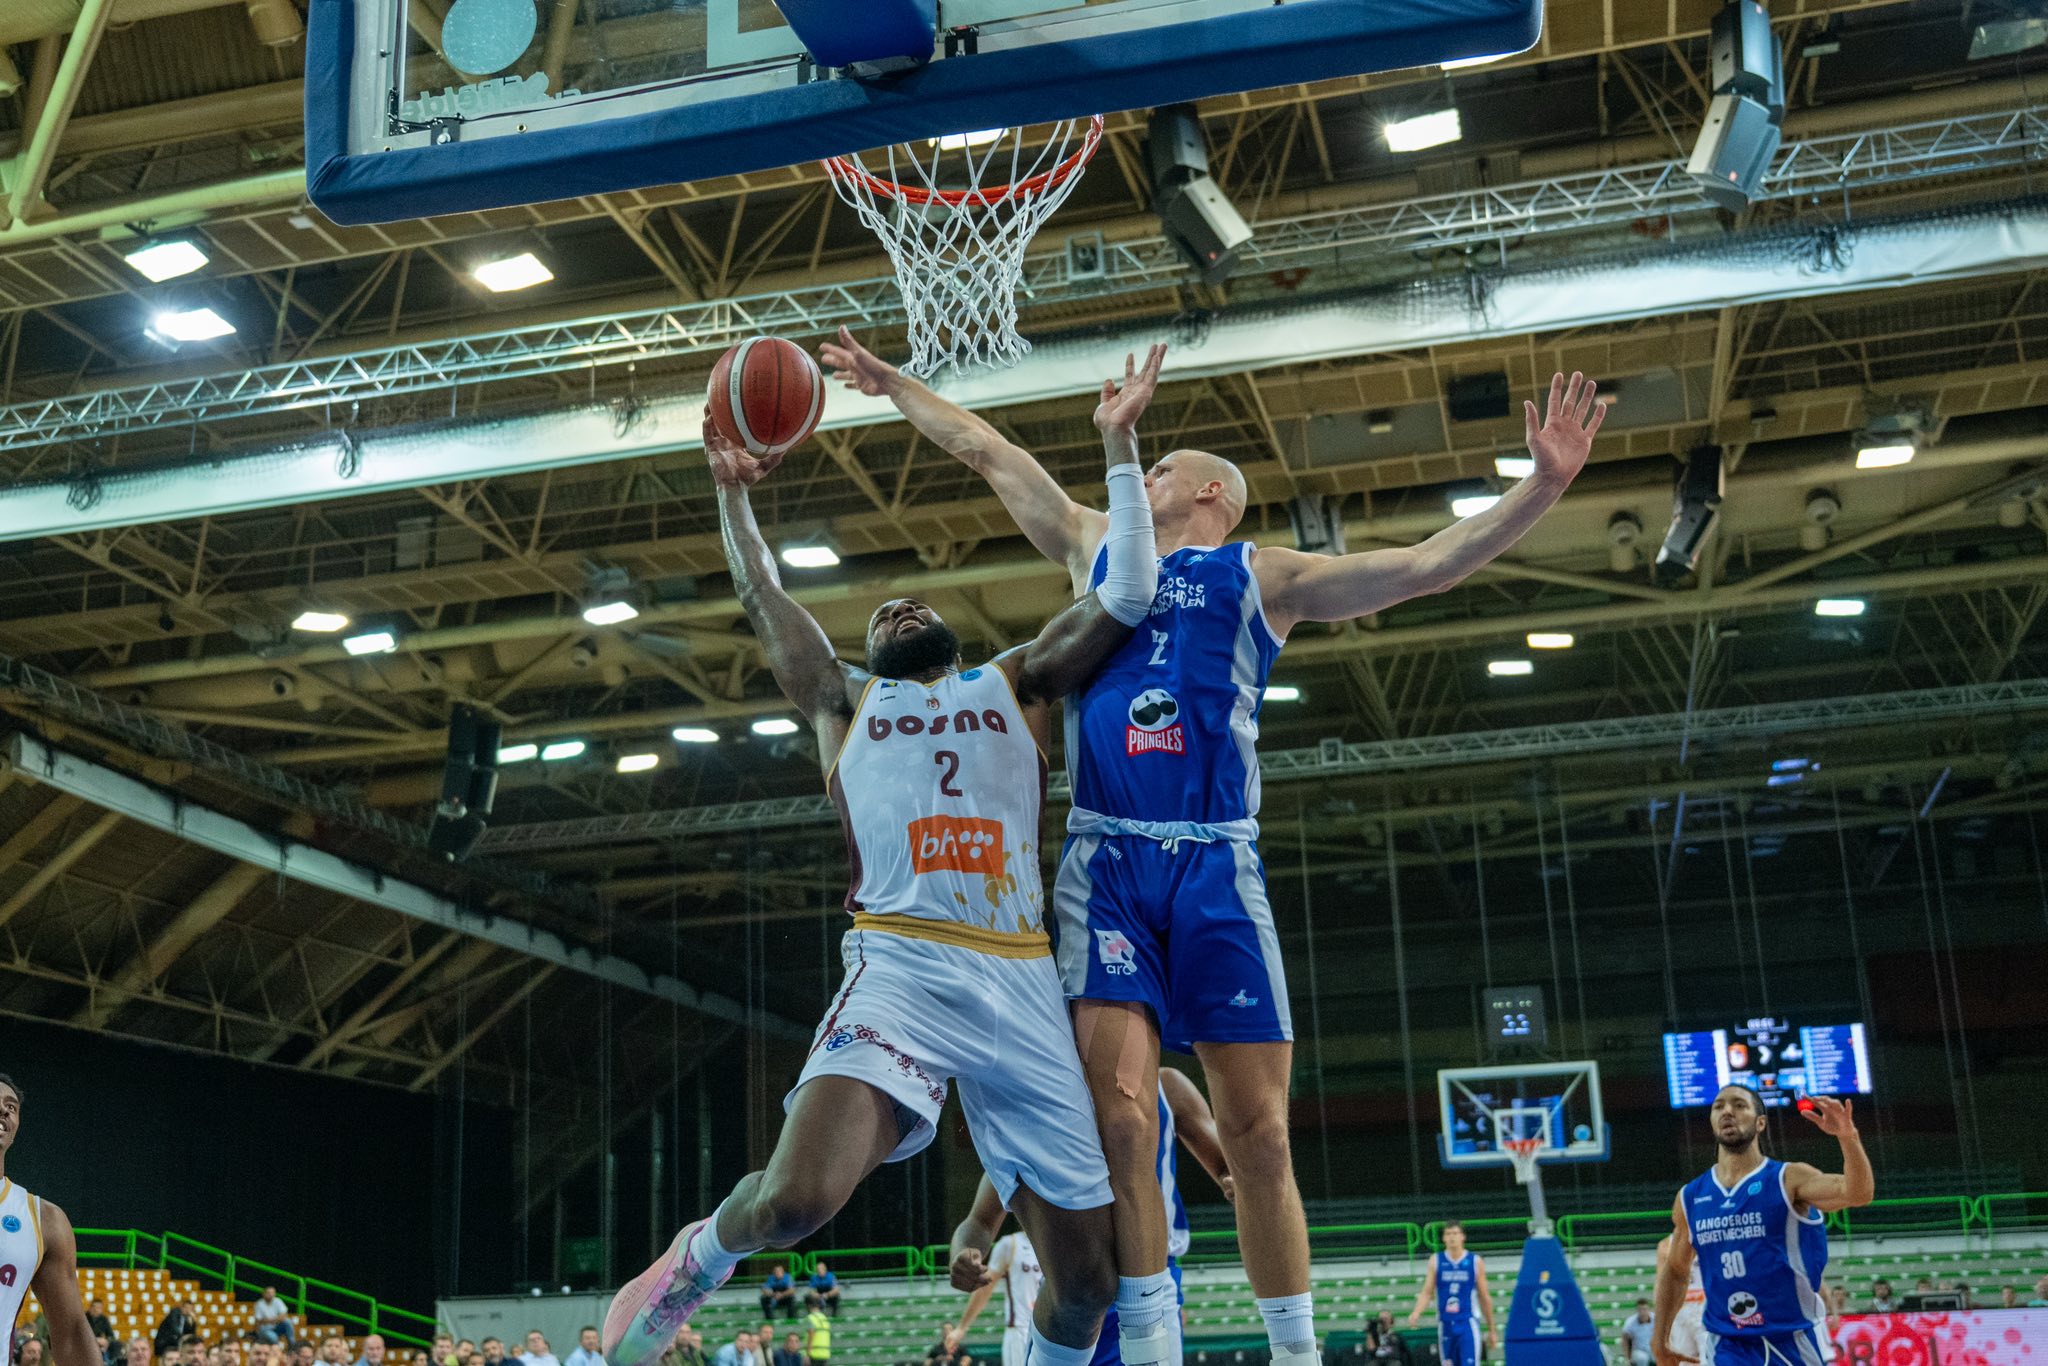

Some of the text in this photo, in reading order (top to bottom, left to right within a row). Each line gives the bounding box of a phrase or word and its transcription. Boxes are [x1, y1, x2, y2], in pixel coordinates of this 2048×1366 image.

[1148, 629, 1168, 665] 2
[867, 709, 1009, 741] bosna
[1129, 727, 1184, 753] PRINGLES
[934, 750, 963, 797] 2
[1695, 1211, 1762, 1232] KANGOEROES
[1720, 1250, 1747, 1280] 30
